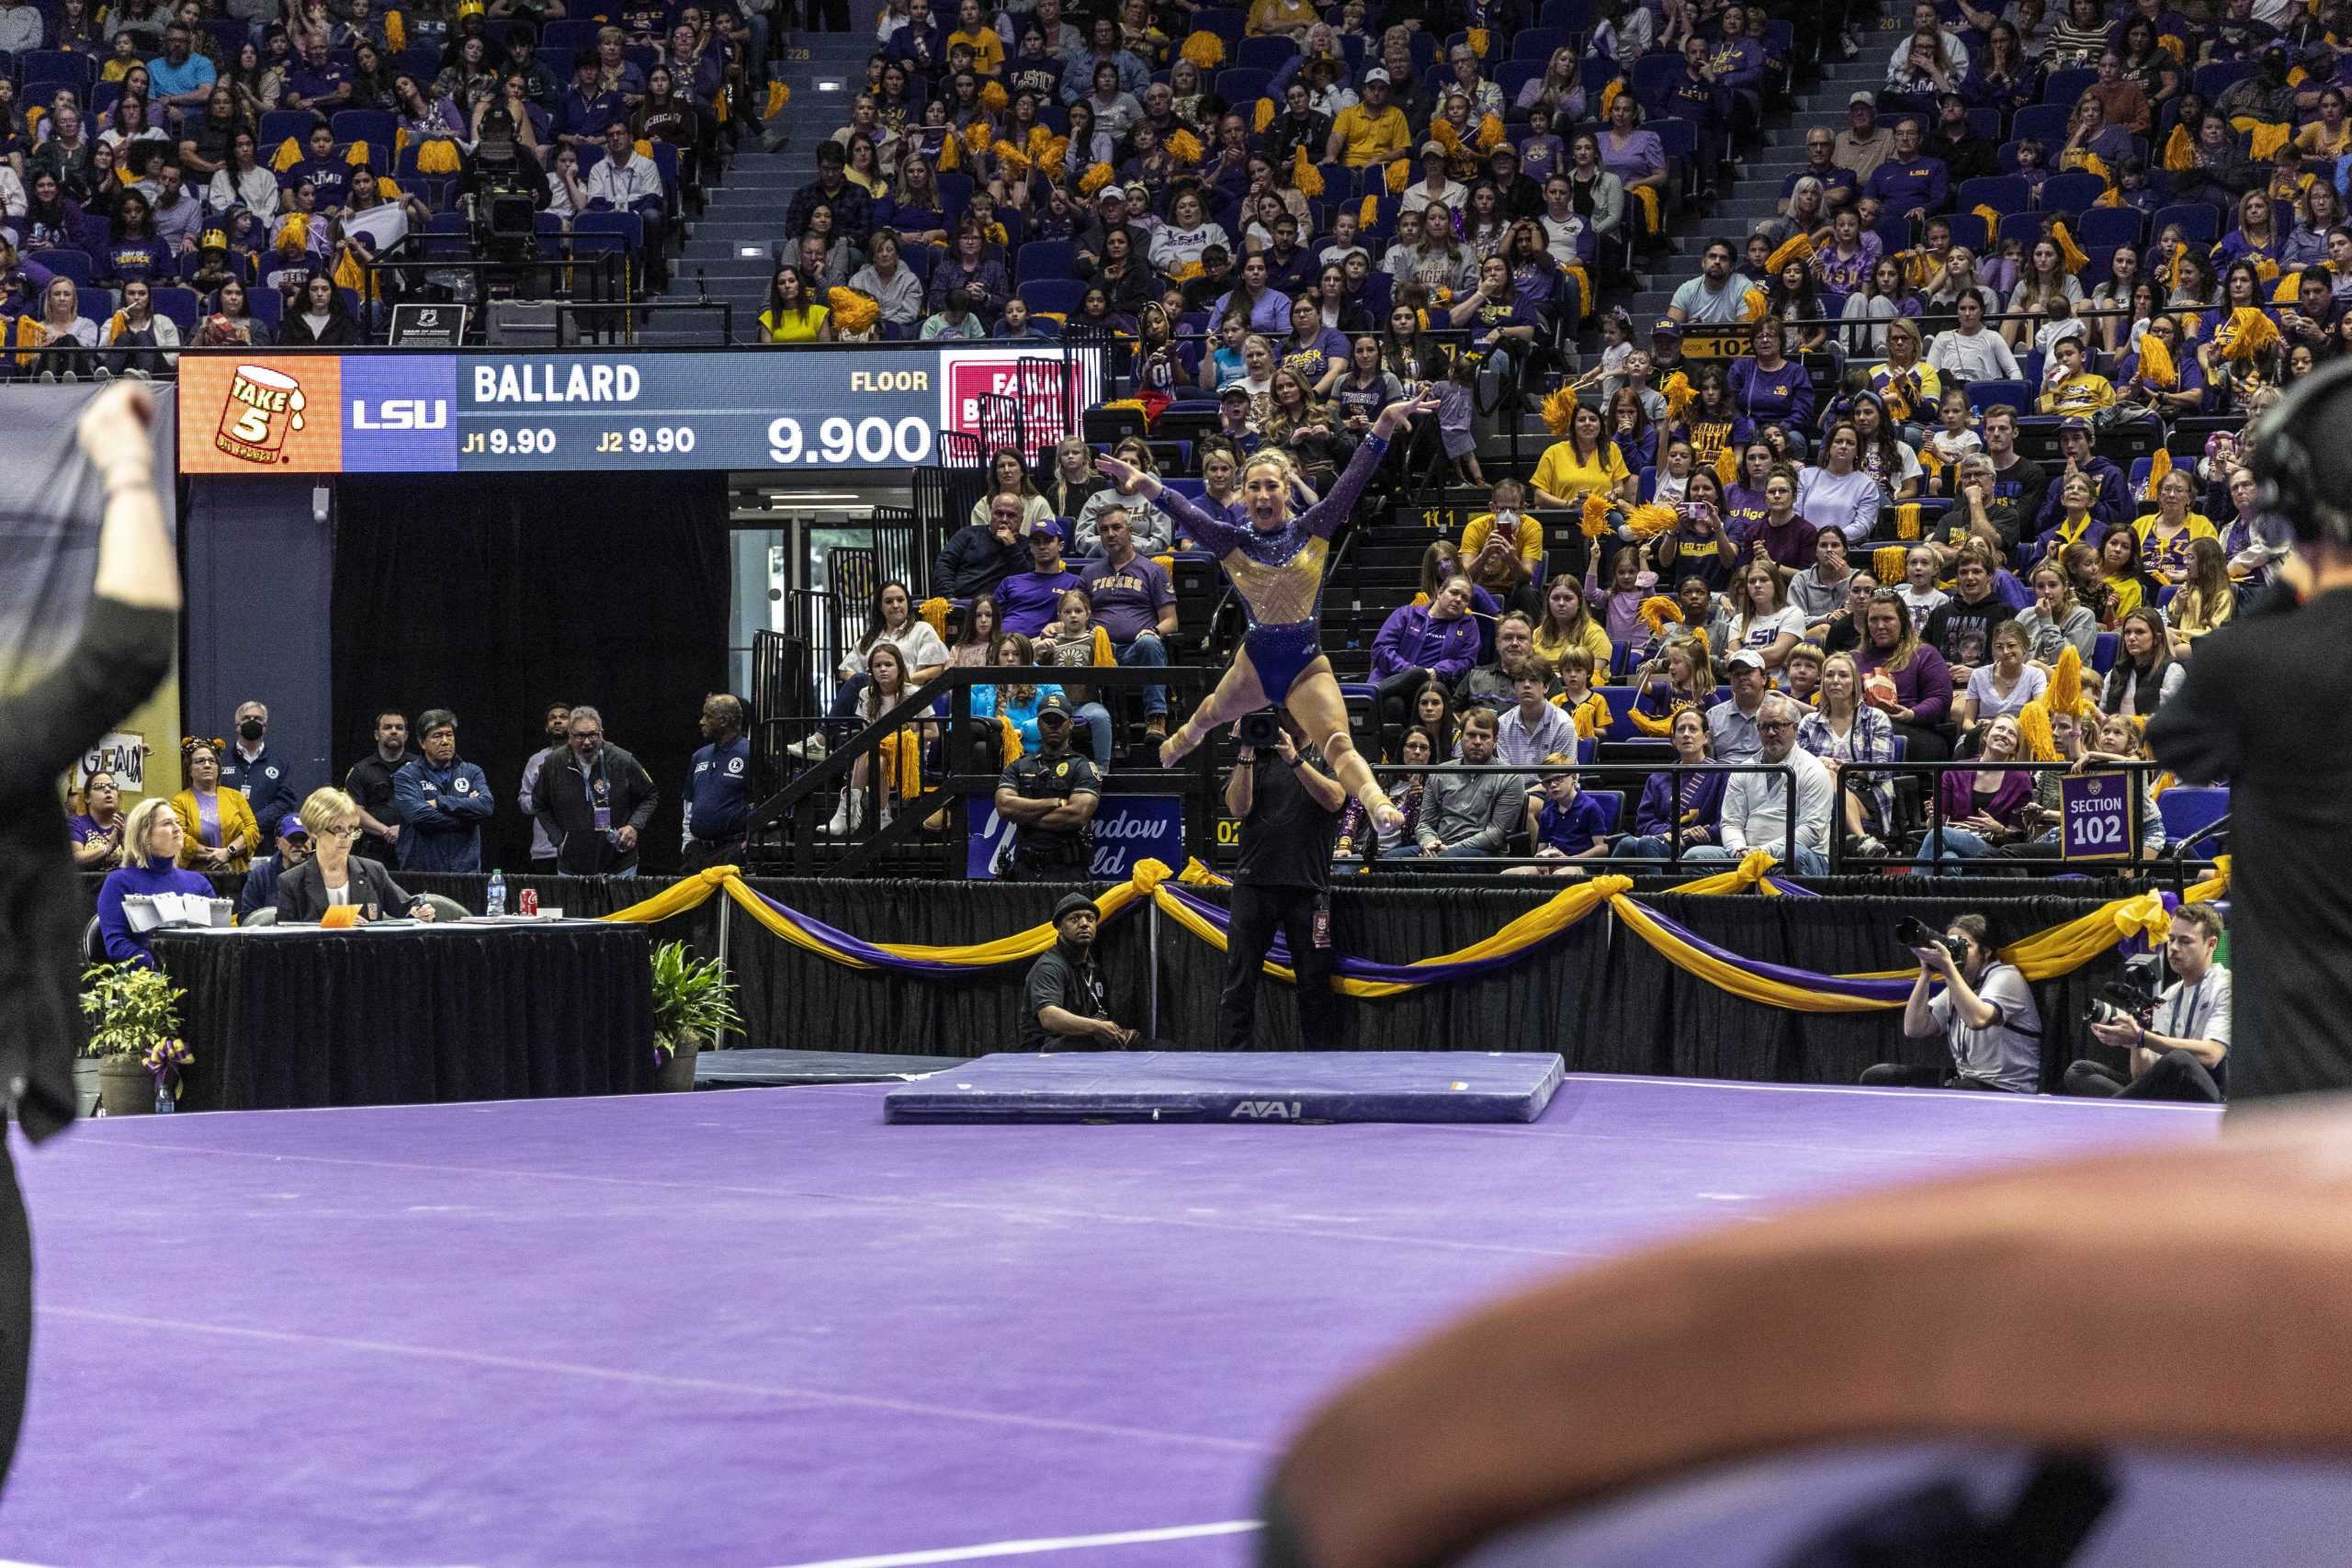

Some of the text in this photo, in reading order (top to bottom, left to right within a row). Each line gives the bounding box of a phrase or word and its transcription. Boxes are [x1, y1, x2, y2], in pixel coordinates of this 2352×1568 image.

[787, 49, 808, 60] 228
[475, 364, 640, 401] BALLARD
[851, 371, 928, 391] FLOOR
[231, 377, 289, 413] TAKE
[232, 406, 270, 443] 5
[353, 399, 447, 430] LSU
[462, 428, 557, 453] J1 9.90
[596, 427, 695, 452] J2 9.90
[768, 416, 931, 463] 9.900
[1742, 507, 1766, 521] tige
[1091, 576, 1143, 592] TIGERS
[2071, 797, 2121, 814] SECTION
[2073, 815, 2121, 845] 102
